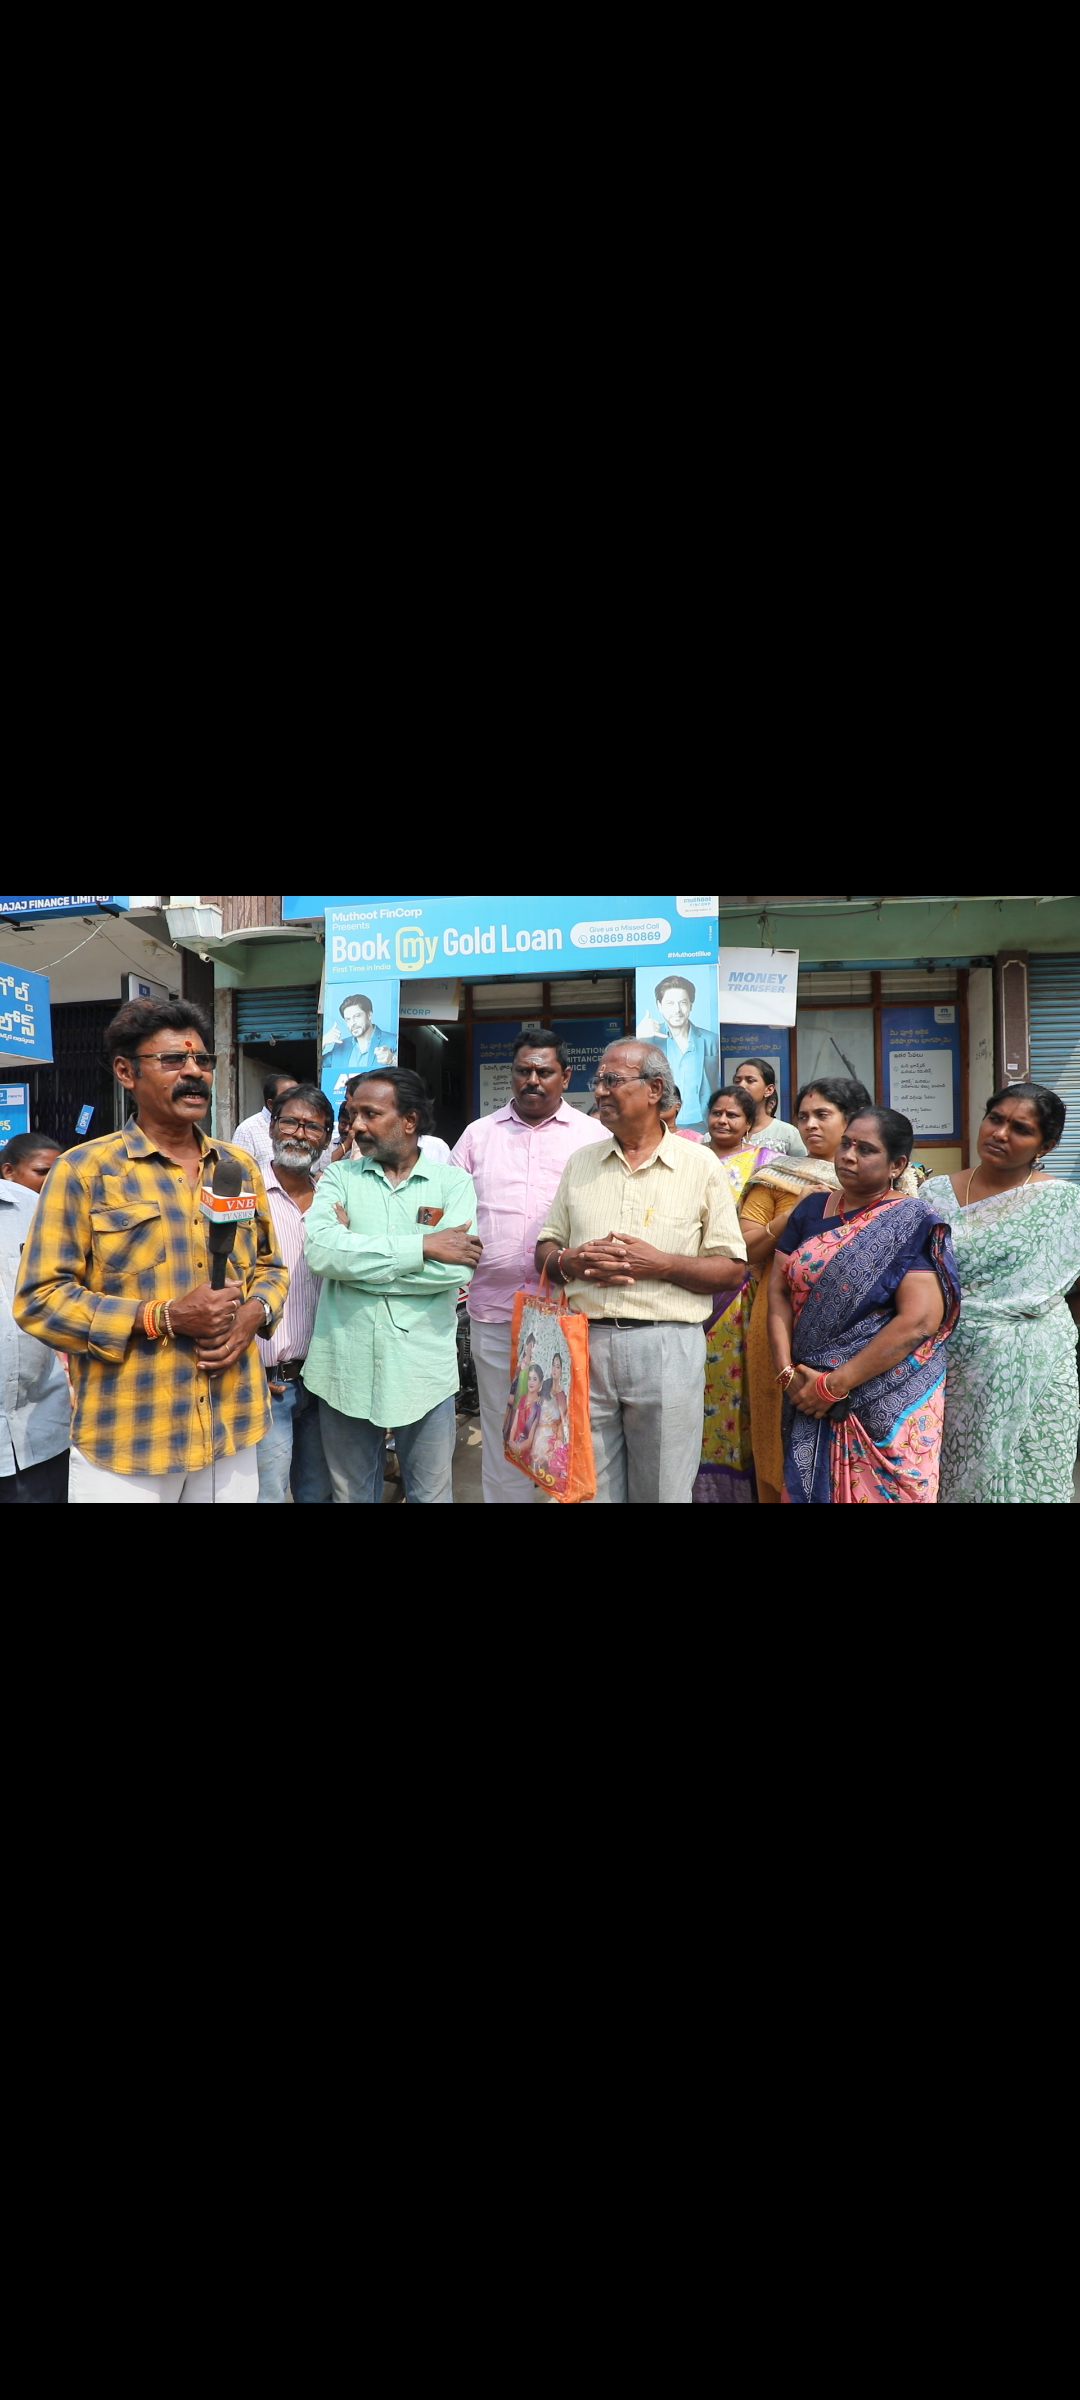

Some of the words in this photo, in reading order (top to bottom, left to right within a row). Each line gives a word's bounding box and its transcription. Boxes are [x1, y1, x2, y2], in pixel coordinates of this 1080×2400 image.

[29, 897, 70, 909] FINANCE
[72, 896, 109, 904] LIMITED
[332, 910, 378, 922] Muthoot
[380, 907, 423, 918] FinCorp
[332, 922, 370, 931] Presents
[589, 934, 624, 944] 80869
[626, 931, 661, 942] 80869
[332, 932, 391, 963] Book
[402, 934, 439, 965] my
[443, 925, 496, 956] Gold
[501, 924, 563, 953] Loan
[667, 950, 712, 958] #MuthootBlue
[348, 964, 365, 972] Time
[374, 963, 391, 971] India
[728, 971, 789, 984] MONEY
[727, 983, 786, 993] TRANSFER
[80, 1111, 90, 1127] OPEN
[226, 1198, 254, 1210] VNB
[233, 1211, 253, 1219] NEWS
